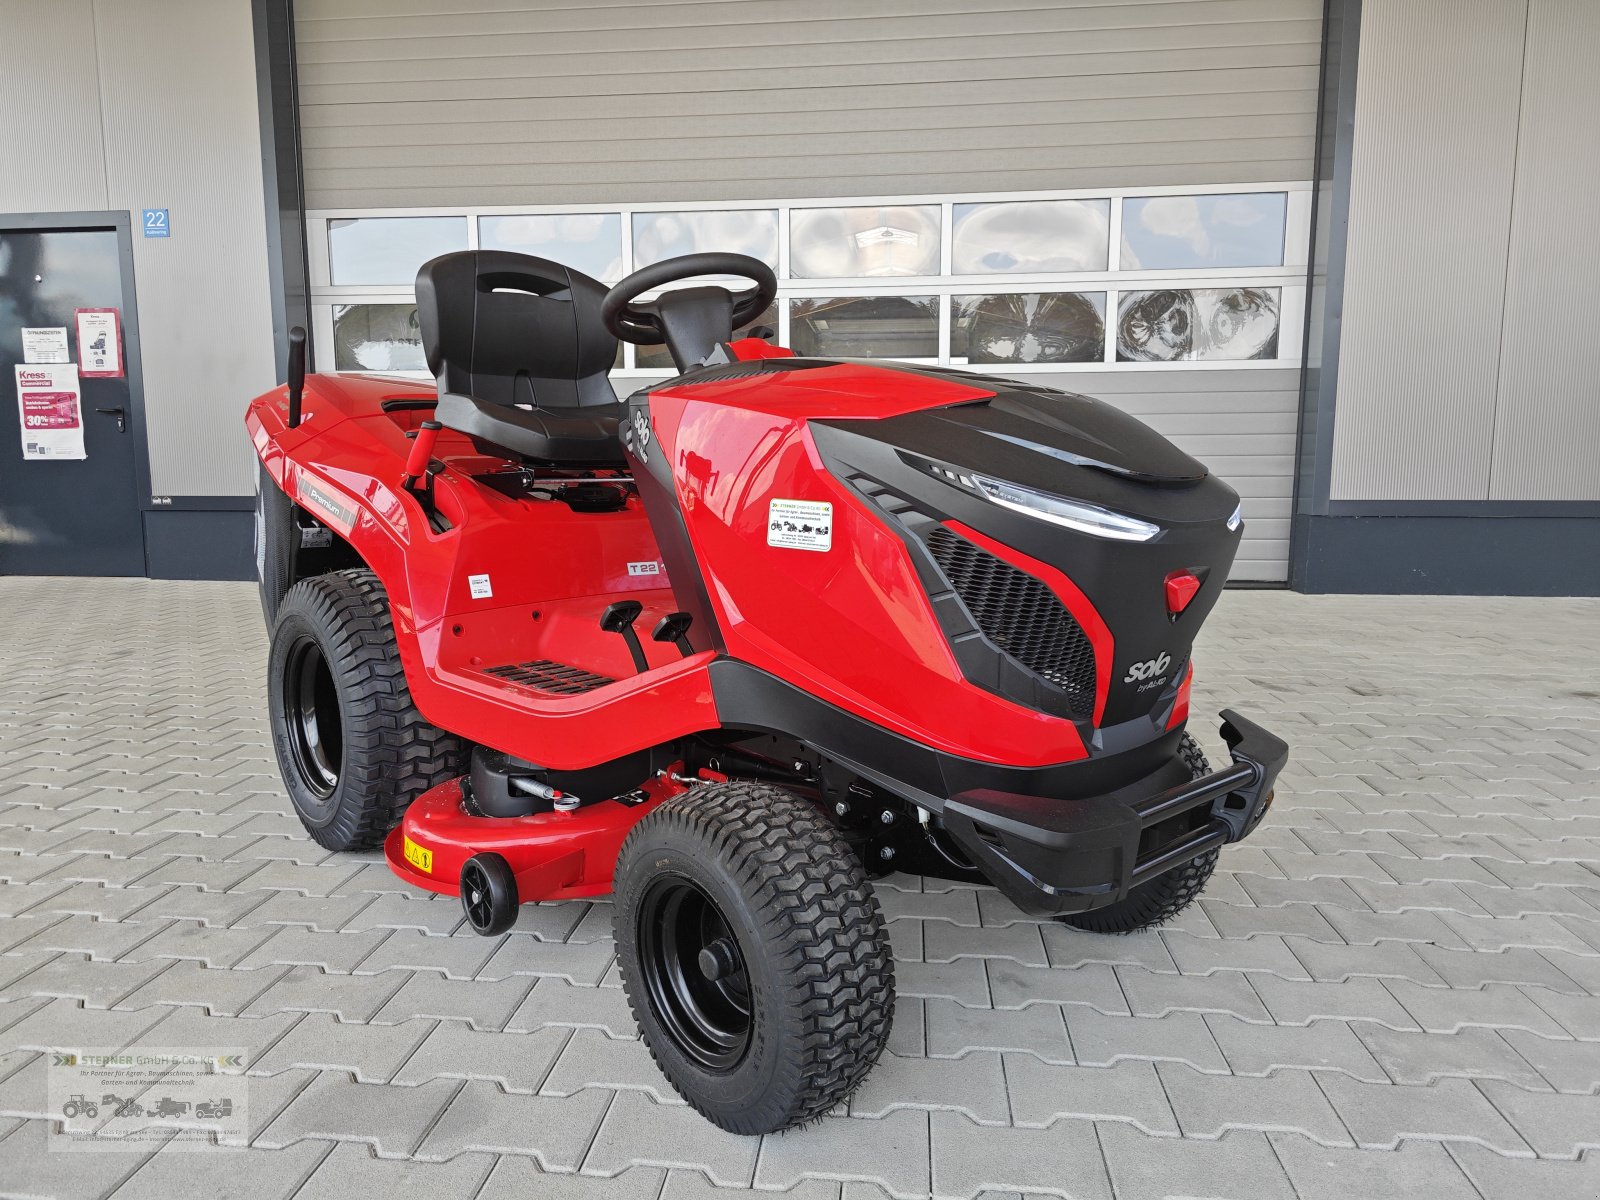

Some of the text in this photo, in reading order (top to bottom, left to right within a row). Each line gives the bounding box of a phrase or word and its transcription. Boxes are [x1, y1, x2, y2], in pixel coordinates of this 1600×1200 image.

[146, 211, 166, 227] 22
[19, 370, 46, 379] Kress
[310, 488, 340, 516] Premium
[640, 563, 657, 573] 22
